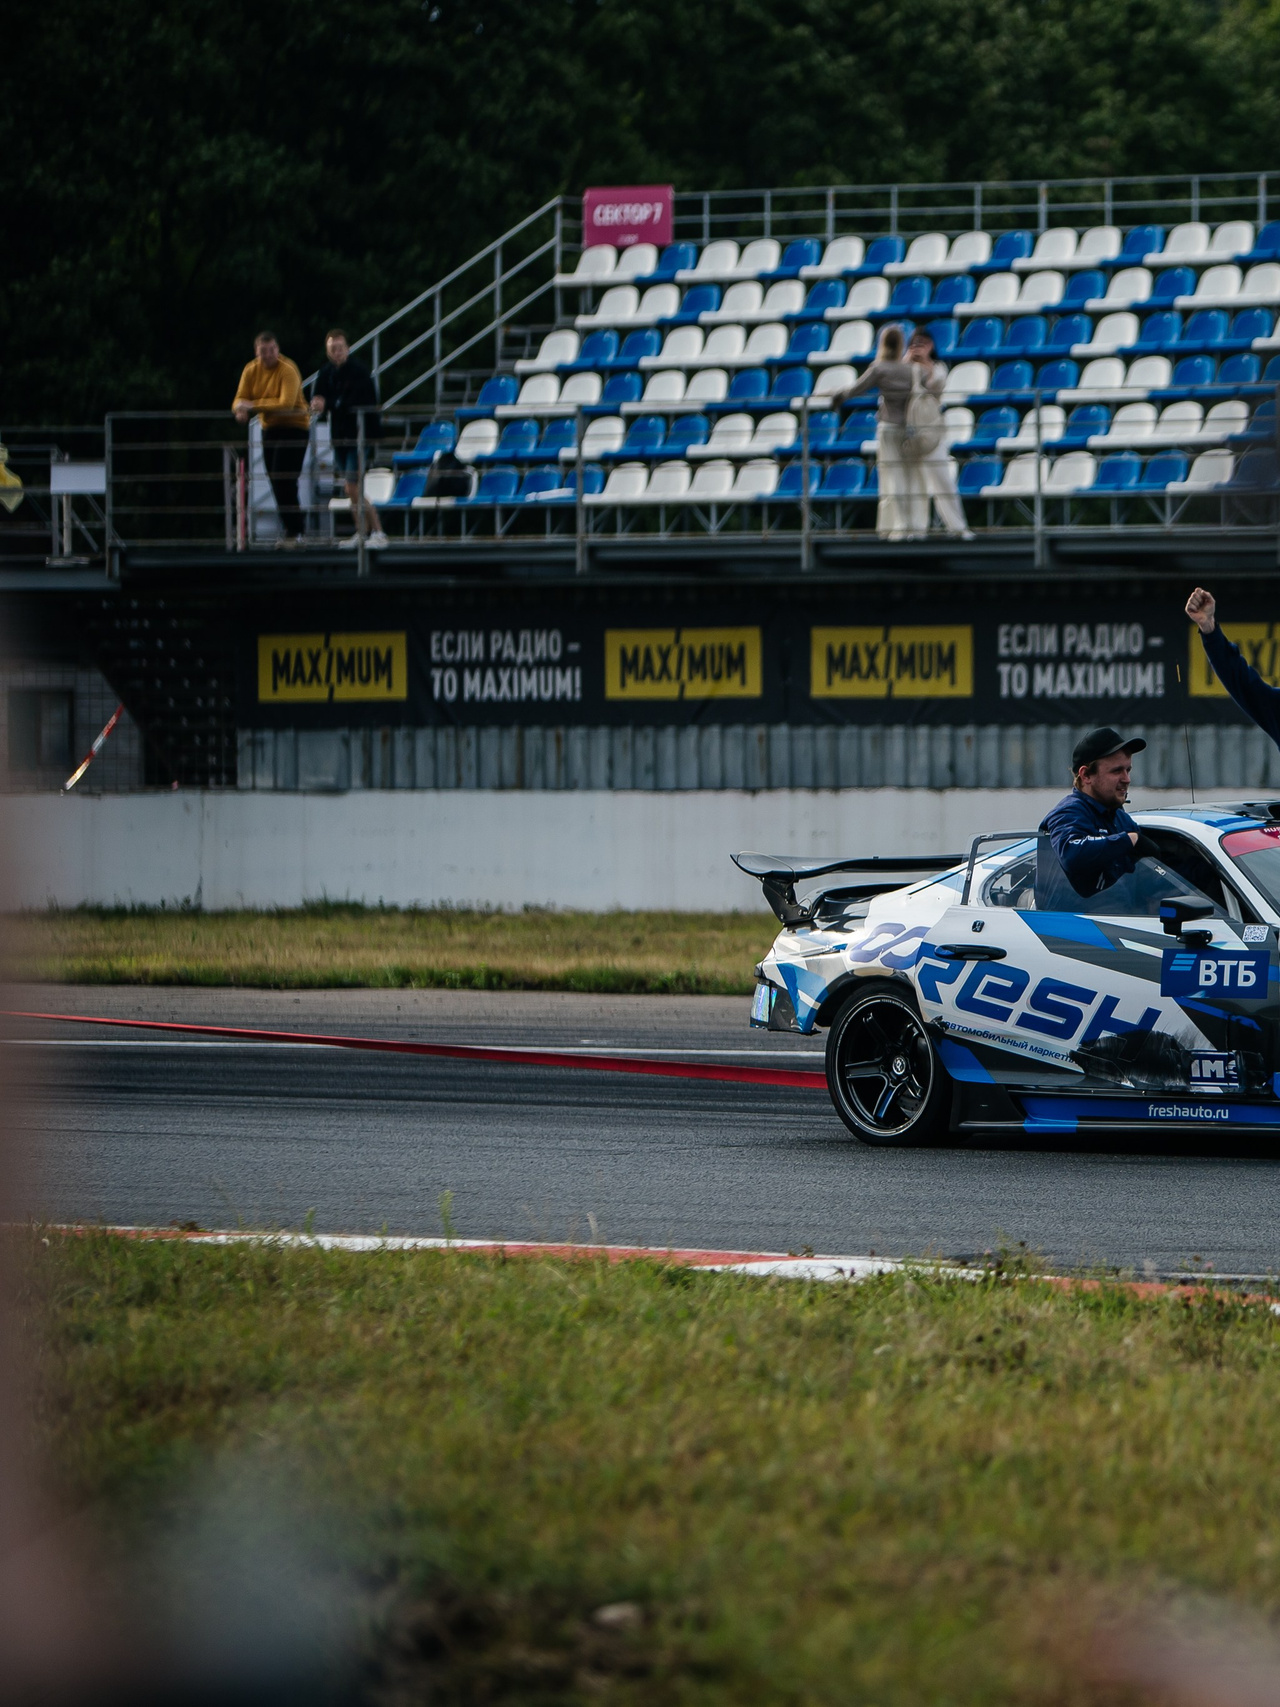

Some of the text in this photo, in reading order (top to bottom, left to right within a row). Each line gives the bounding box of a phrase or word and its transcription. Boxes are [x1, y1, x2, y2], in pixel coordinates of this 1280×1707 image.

[430, 630, 484, 662] ЕСЛИ
[490, 629, 562, 665] РАДИО
[998, 623, 1058, 657] ЕСЛИ
[1063, 622, 1145, 661] РАДИО
[463, 666, 582, 700] MAXIMUM!
[1033, 662, 1165, 698] MAXIMUM!
[1199, 960, 1256, 987] ВТБ
[1148, 1104, 1229, 1119] freshauto.ru
